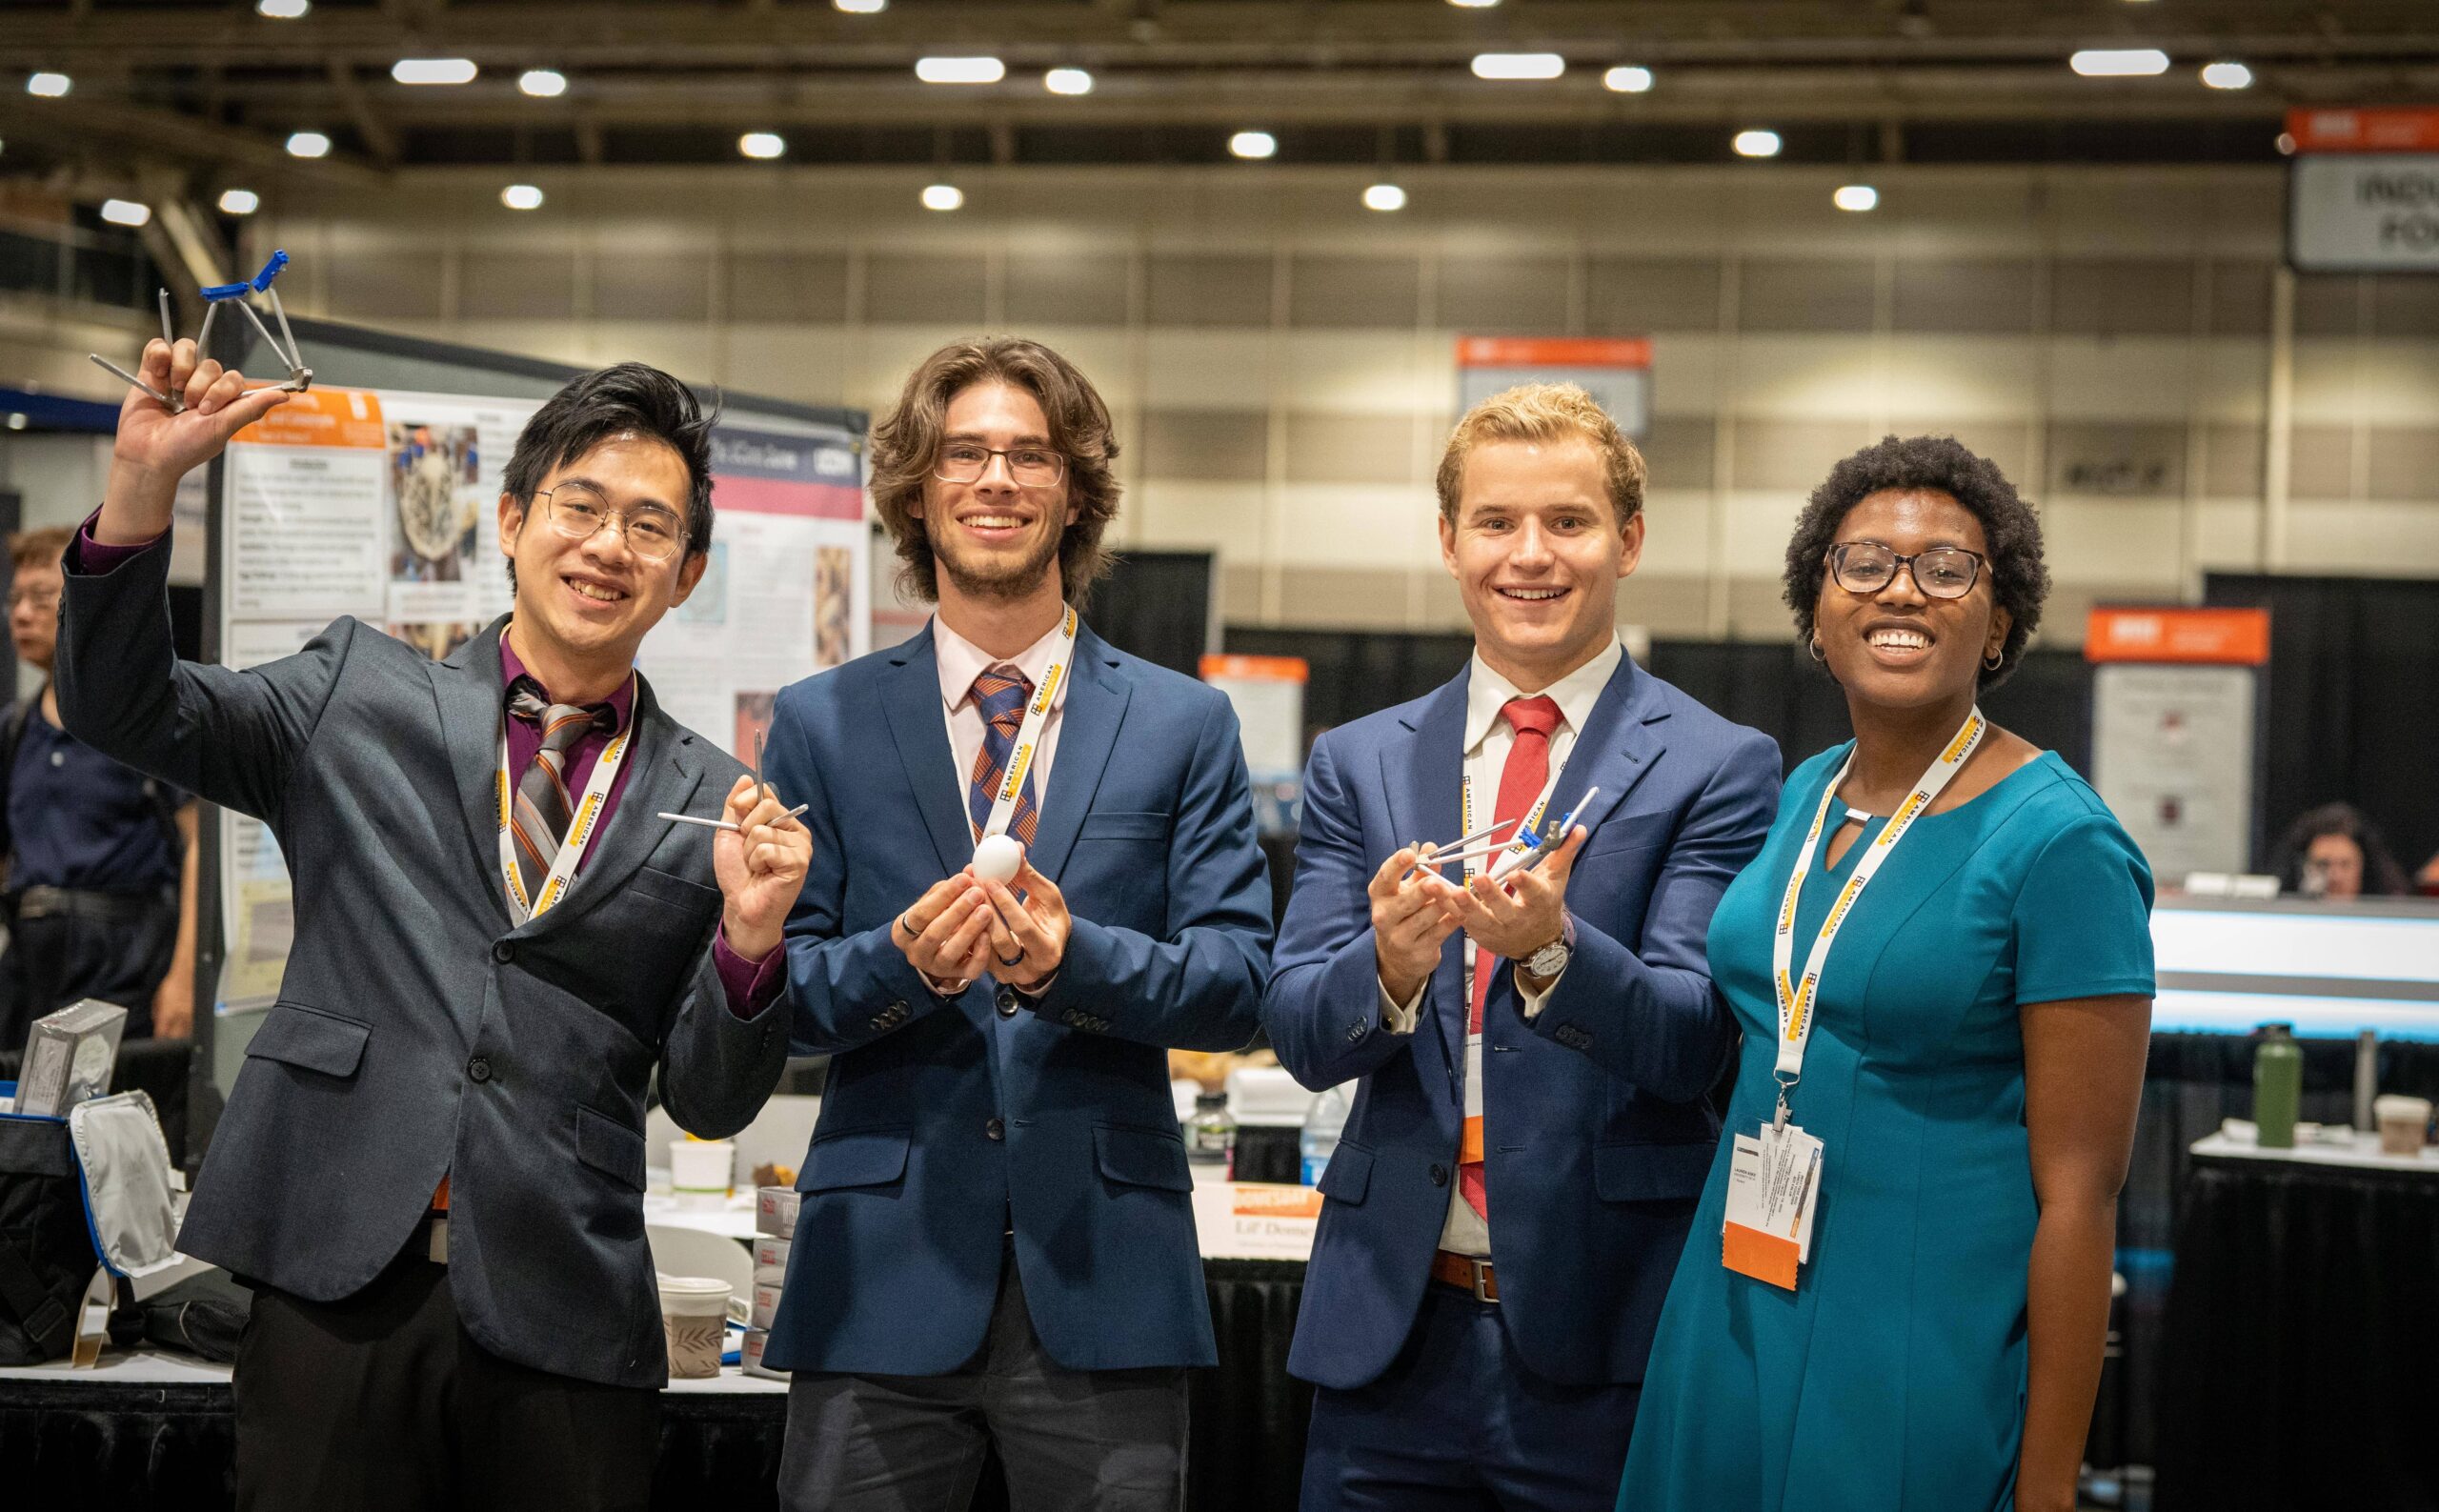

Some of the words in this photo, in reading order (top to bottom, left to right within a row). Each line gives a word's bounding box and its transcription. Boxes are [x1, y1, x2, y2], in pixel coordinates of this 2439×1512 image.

[1037, 664, 1054, 701] AMERICAN
[1953, 727, 1981, 763] AMERICAN
[1005, 745, 1023, 787] AMERICAN
[579, 805, 598, 846] AMERICAN
[1524, 800, 1545, 829] ERICAN
[1887, 805, 1920, 844] AMERICAN
[1829, 890, 1856, 934] AMERICAN
[1777, 976, 1788, 1024] AMERICAN
[1798, 989, 1813, 1038] AMERICAN
